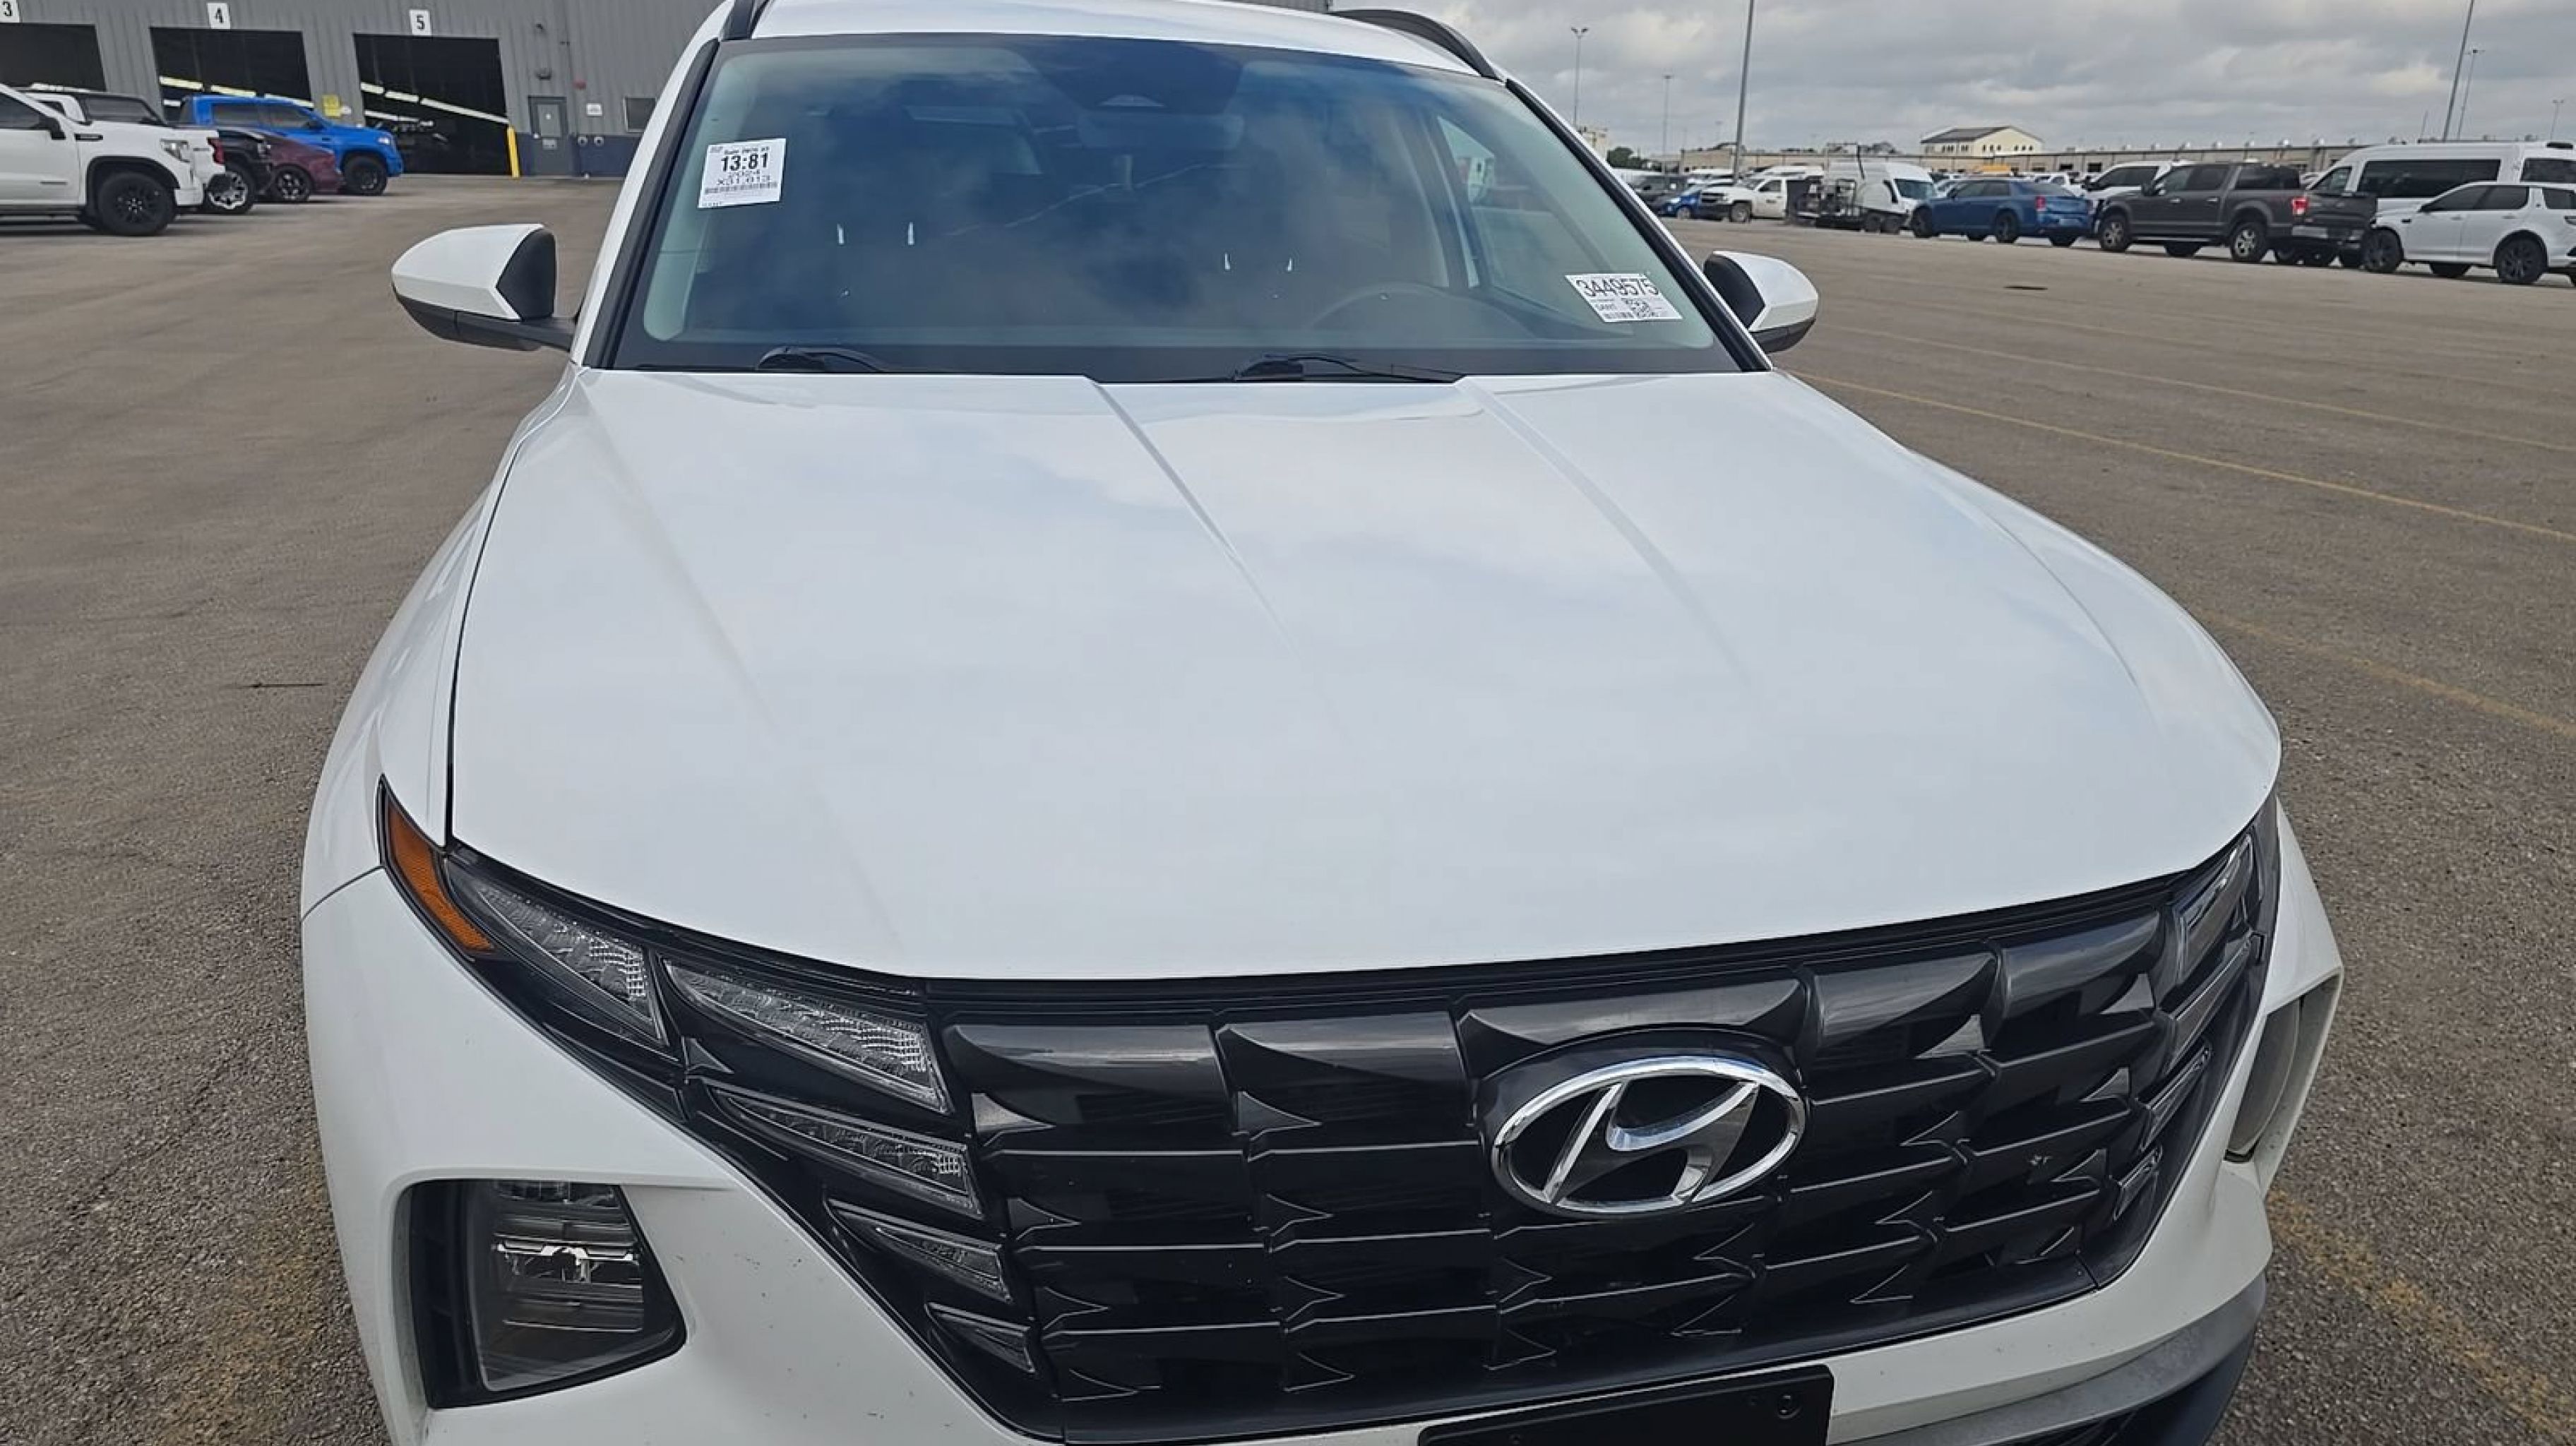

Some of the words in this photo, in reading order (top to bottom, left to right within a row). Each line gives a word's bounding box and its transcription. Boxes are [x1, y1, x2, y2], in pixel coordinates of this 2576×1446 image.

[3, 1, 13, 17] 3
[215, 7, 224, 24] 4
[417, 15, 425, 30] 5
[721, 153, 768, 172] 13:81
[1576, 277, 1659, 297] 3449575
